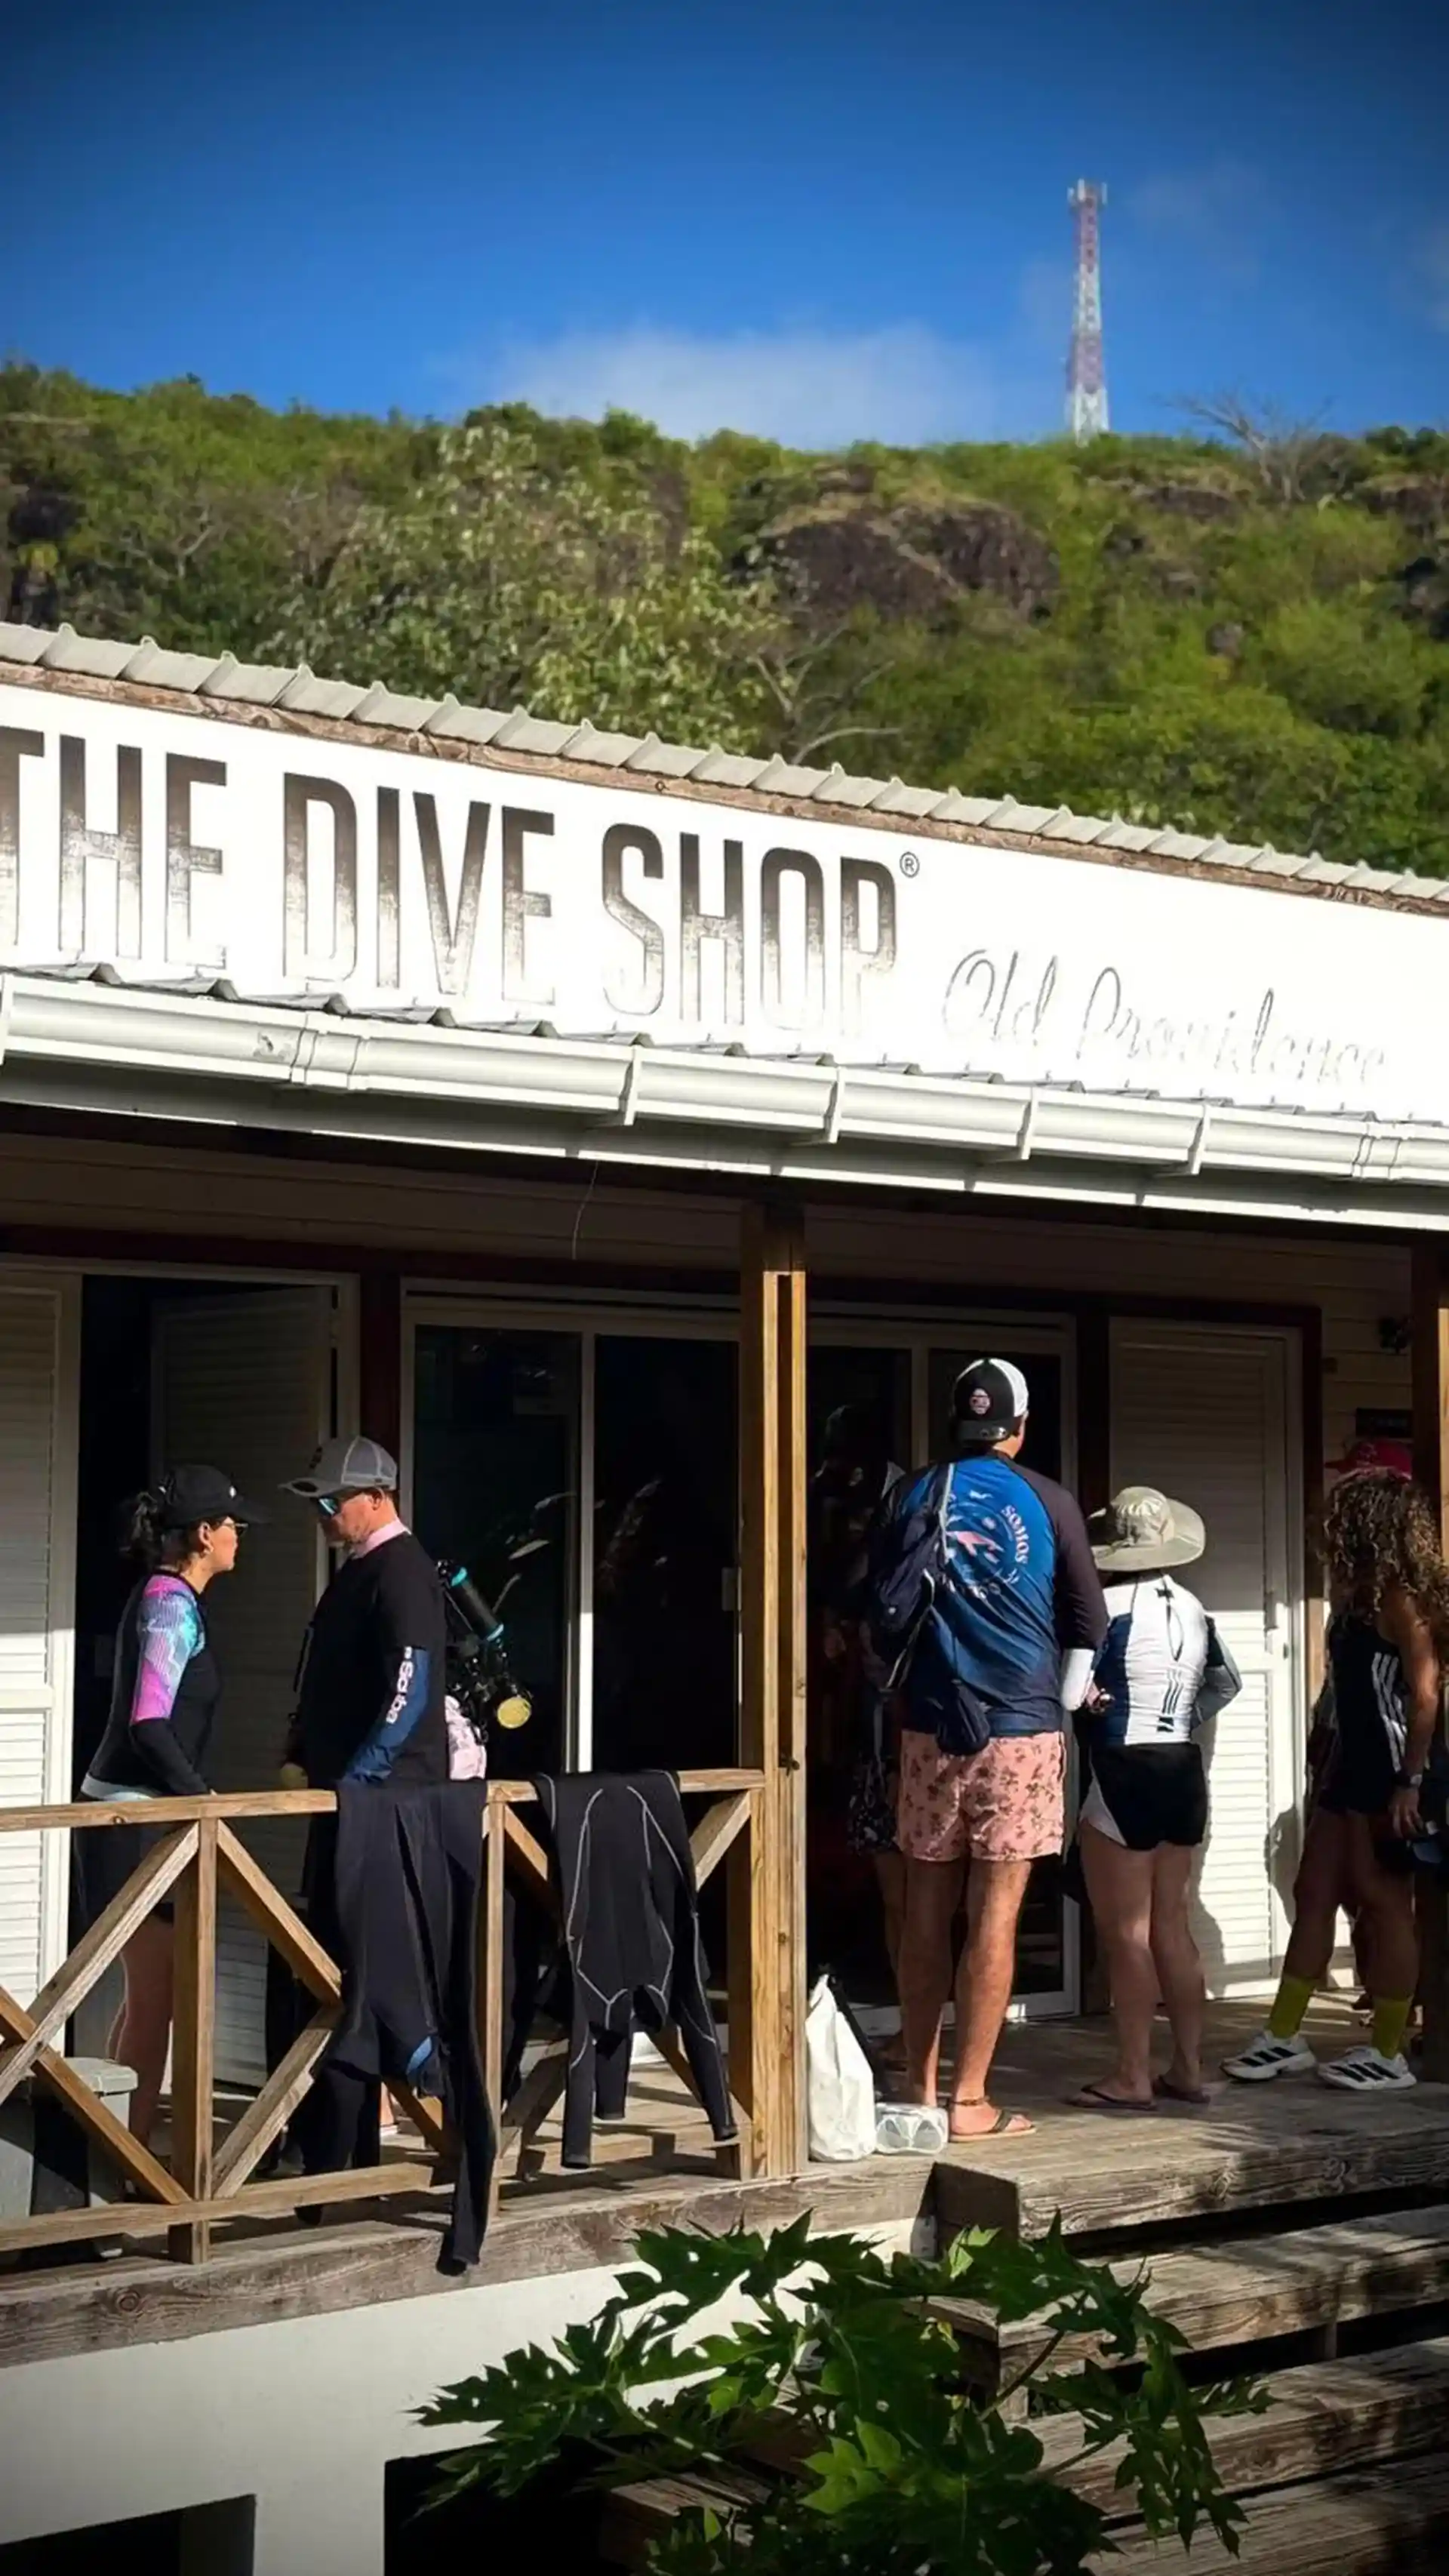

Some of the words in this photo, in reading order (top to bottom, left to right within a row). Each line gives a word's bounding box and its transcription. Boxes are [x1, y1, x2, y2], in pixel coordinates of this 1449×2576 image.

[0, 725, 227, 971] THE
[283, 771, 555, 1005] DIVE
[942, 949, 1059, 1047] Old
